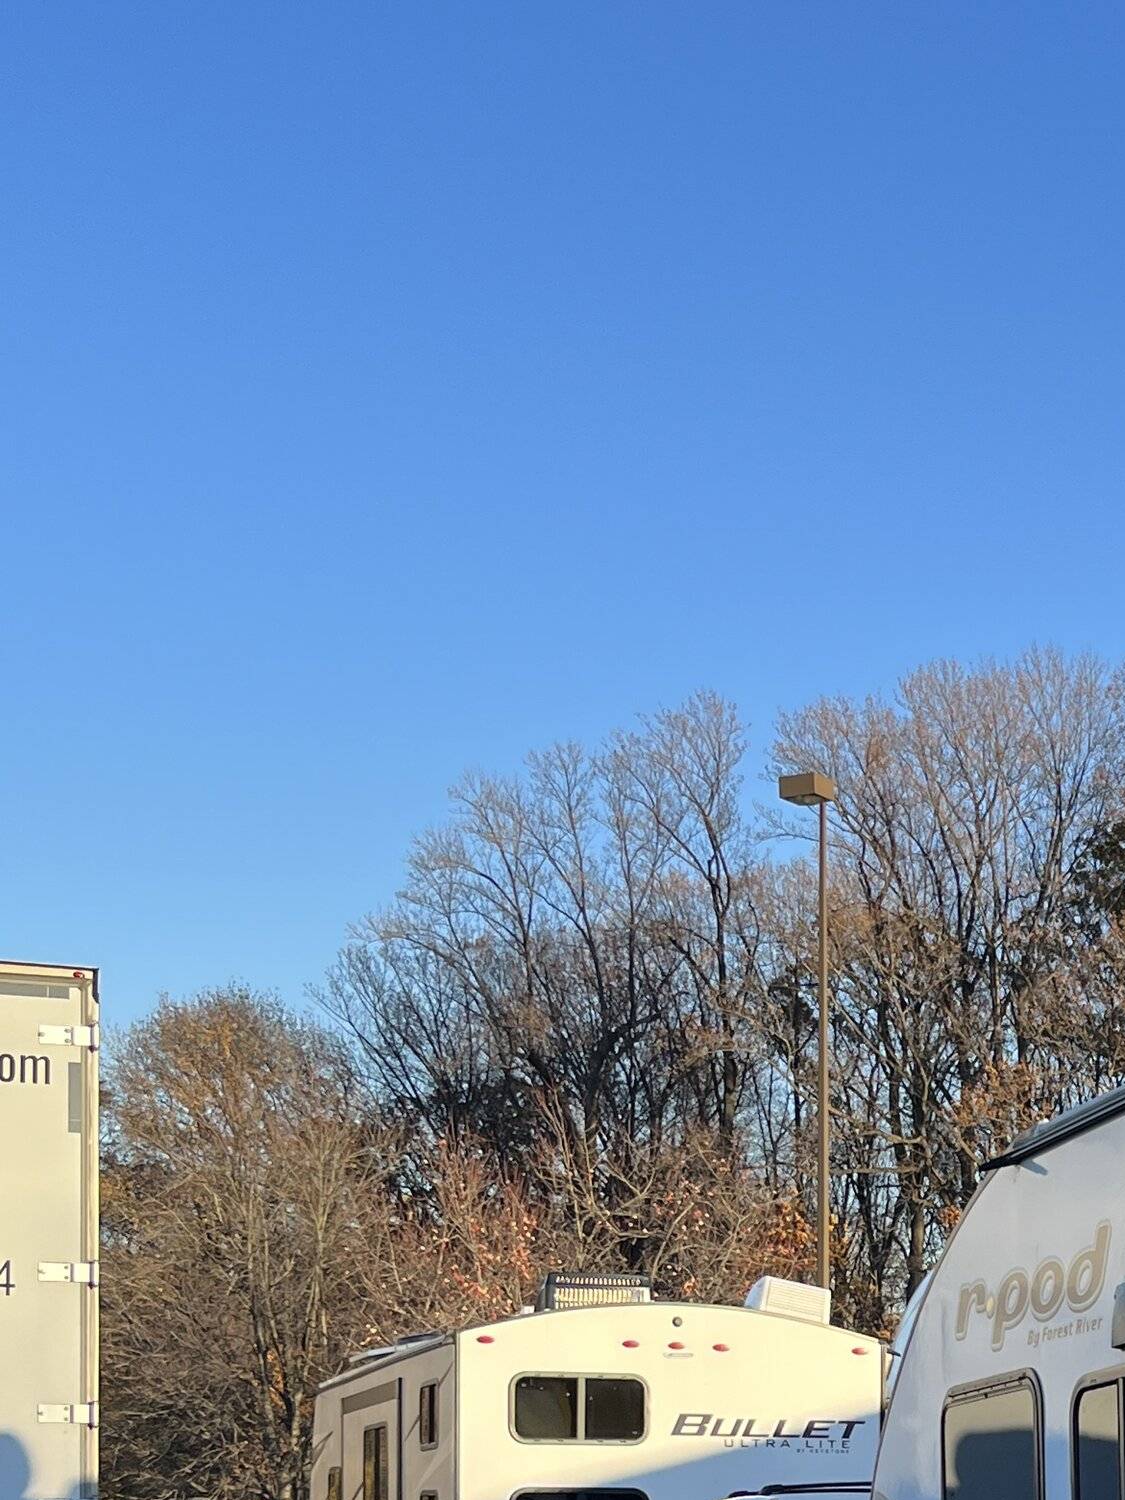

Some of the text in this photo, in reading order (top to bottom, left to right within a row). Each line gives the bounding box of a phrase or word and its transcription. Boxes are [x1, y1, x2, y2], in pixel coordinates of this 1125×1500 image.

[0, 1260, 16, 1296] 4
[1027, 1317, 1103, 1348] By Forest River
[671, 1413, 866, 1439] BULLET
[724, 1439, 850, 1449] ULTRA LITE
